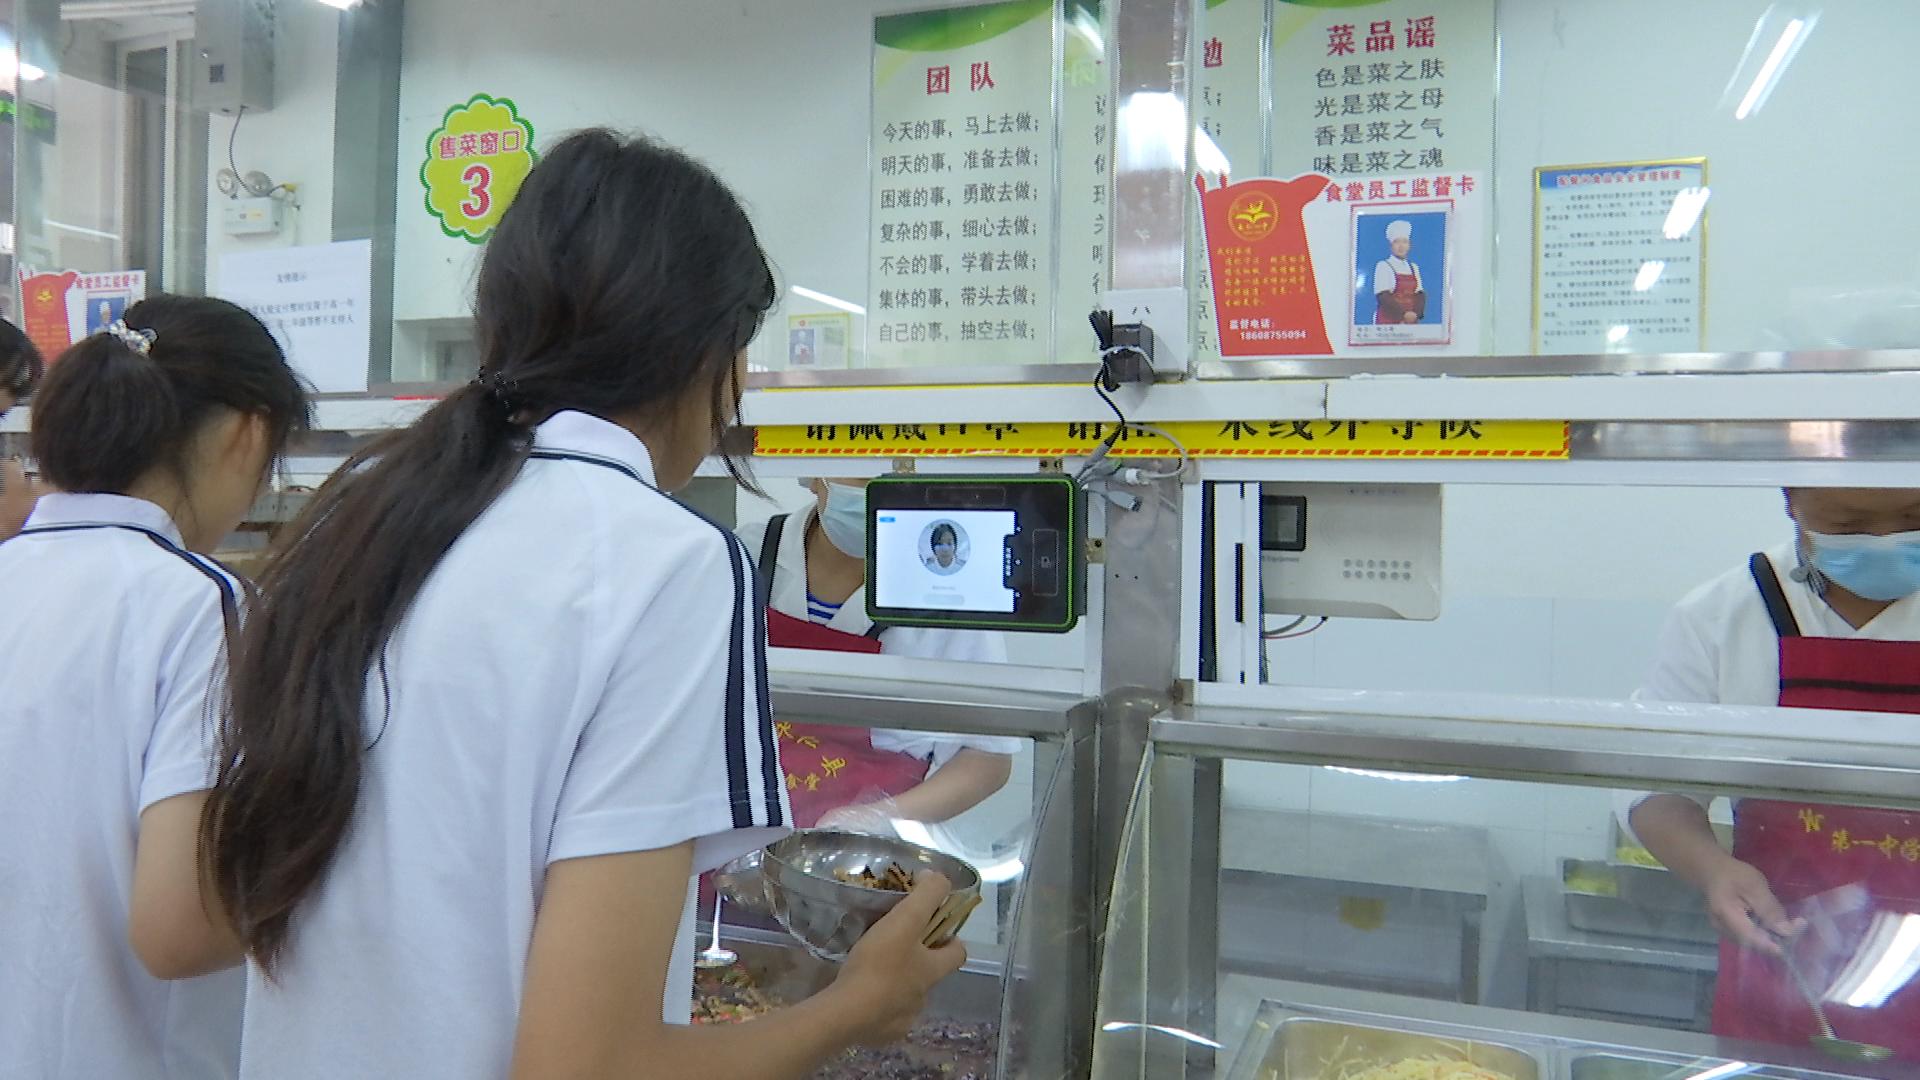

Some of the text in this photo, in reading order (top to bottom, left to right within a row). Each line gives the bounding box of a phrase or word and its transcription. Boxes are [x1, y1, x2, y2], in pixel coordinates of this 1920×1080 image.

[1326, 16, 1437, 57] 菜品谣
[926, 61, 995, 95] 团队
[1314, 58, 1445, 88] 色是菜之肤
[1314, 88, 1445, 118] 光是菜之母
[440, 130, 520, 159] 售菜窗口
[1314, 118, 1444, 147] 香是菜之气
[1313, 148, 1444, 175] 味是菜之魂
[462, 165, 491, 217] 3
[1324, 175, 1475, 202] 食堂员工监督卡
